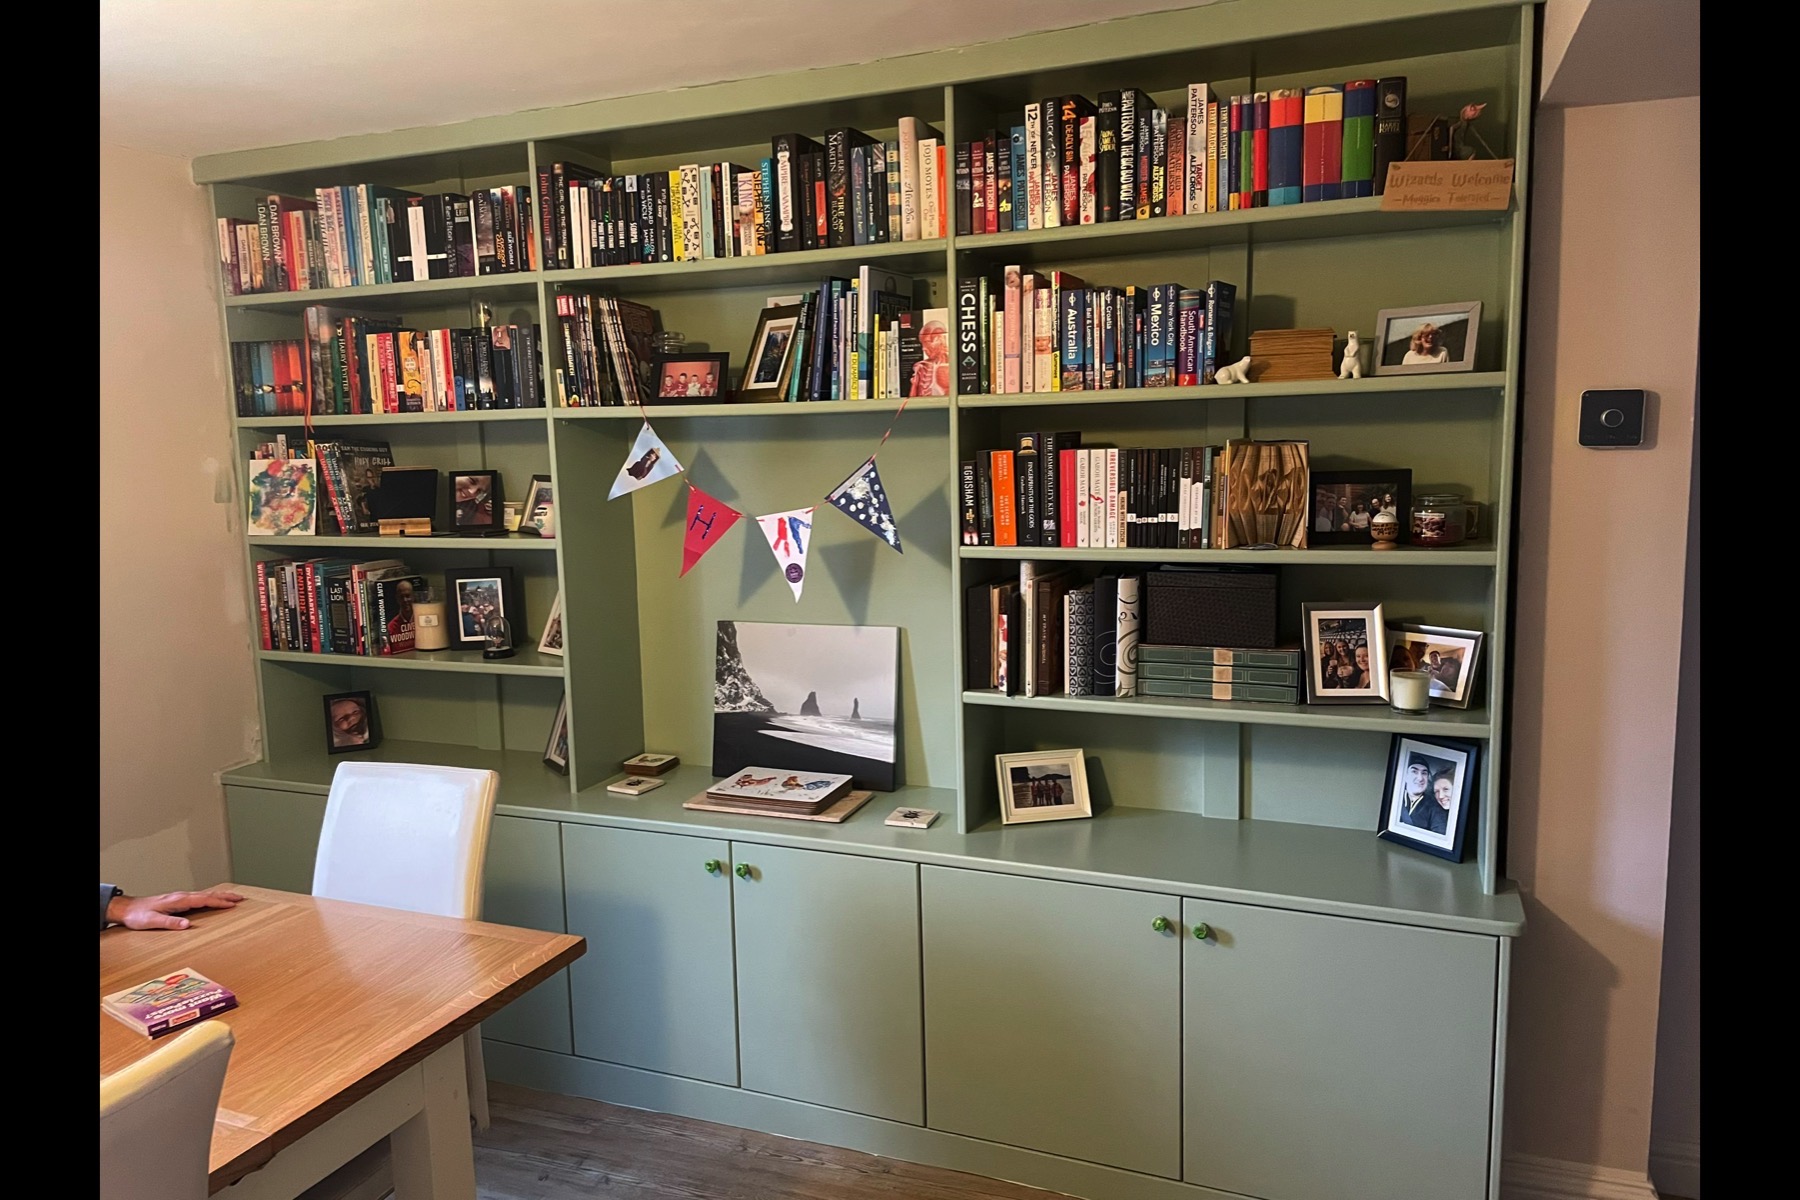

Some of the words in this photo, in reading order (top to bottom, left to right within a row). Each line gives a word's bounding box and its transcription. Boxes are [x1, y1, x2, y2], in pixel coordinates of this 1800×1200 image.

[1121, 99, 1134, 143] PATTERSON
[1220, 106, 1228, 124] TERRY
[1065, 124, 1073, 150] DEADLY
[1121, 144, 1134, 157] THE
[1209, 126, 1217, 160] PRATCHETT
[1220, 126, 1228, 160] PRATCHETT
[828, 134, 837, 172] MARTIN
[923, 144, 931, 165] JOJO
[986, 152, 995, 173] JAMES
[1016, 154, 1025, 177] JAMES
[1121, 158, 1133, 170] BIG
[780, 155, 788, 184] EMPIRE
[1121, 170, 1133, 184] BAD
[1140, 155, 1148, 181] MURDER
[1390, 172, 1443, 188] Wizards
[1452, 172, 1510, 188] Welcome
[540, 173, 549, 194] John
[739, 179, 753, 207] KING
[754, 173, 765, 213] STEPHEN
[761, 162, 769, 203] STEPHEN
[904, 182, 914, 207] After
[986, 174, 995, 211] PATTERSON
[1064, 165, 1072, 211] PATTERSON
[1121, 184, 1134, 201] WOLF
[1140, 183, 1148, 204] GAMES
[269, 205, 278, 224] DAN
[560, 205, 565, 214] ON
[1017, 180, 1026, 221] PATTERSON
[257, 206, 266, 226] DAN
[542, 197, 551, 234] Grisham
[905, 207, 915, 225] You
[260, 227, 270, 261] BROWN
[271, 226, 281, 259] BROWN
[319, 214, 329, 256] WITCHES
[756, 223, 766, 246] KING
[961, 293, 976, 353] CHESS
[1067, 308, 1078, 359] Australia
[1151, 304, 1162, 346] Mexico
[1179, 311, 1188, 352] Handbook
[1188, 311, 1196, 334] South
[338, 338, 347, 364] HARRY
[1187, 335, 1195, 372] American
[963, 470, 974, 506] GRISHAM
[257, 564, 265, 585] WAYNE
[297, 568, 305, 613] ENDURE
[378, 599, 386, 633] WOODWARD
